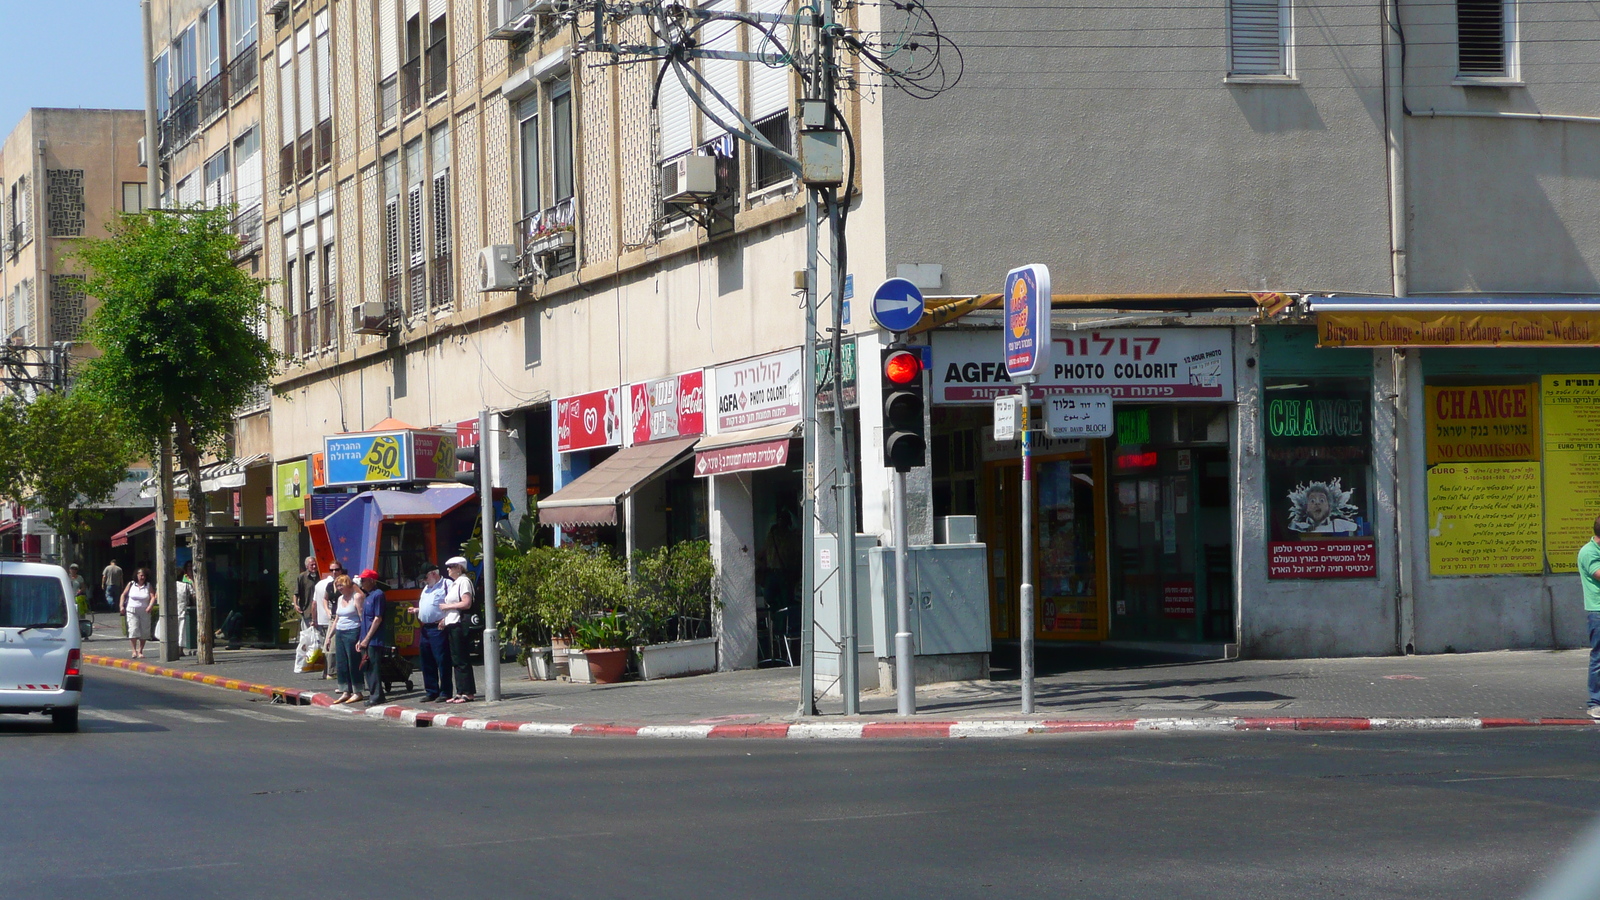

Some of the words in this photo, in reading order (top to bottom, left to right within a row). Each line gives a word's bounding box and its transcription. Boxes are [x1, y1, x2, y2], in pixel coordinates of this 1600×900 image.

[1327, 322, 1358, 341] Bureau
[1363, 322, 1375, 341] De
[1379, 321, 1413, 345] Change
[1421, 321, 1455, 345] Foreign
[1460, 321, 1501, 344] Exchange
[1512, 321, 1544, 341] Cambio
[1553, 321, 1589, 340] Wechsel
[1191, 353, 1205, 362] HOUR
[1206, 349, 1222, 358] PHOTO
[734, 360, 781, 388] קולורית
[944, 362, 1011, 382] AGFA
[1054, 363, 1104, 379] PHOTO
[1114, 363, 1178, 379] COLORIT
[1131, 386, 1174, 396] פיתוח
[719, 393, 738, 413] AGFA
[750, 389, 764, 405] PHOTO
[766, 385, 787, 402] COLORIT
[1053, 398, 1076, 410] בלוך
[1437, 389, 1527, 420] CHANGE
[739, 415, 745, 424] 30
[1269, 399, 1363, 436] CHANGE
[1437, 424, 1467, 437] ישראל
[1471, 425, 1489, 439] בנק
[1493, 424, 1527, 435] באישור
[330, 442, 361, 451] ההגרלה
[1437, 444, 1453, 458] NO
[1457, 443, 1531, 457] COMMISSION
[331, 452, 361, 461] הגדולה
[368, 442, 397, 469] 50
[438, 441, 453, 469] 50
[369, 464, 390, 478] מיליון
[1273, 544, 1292, 554] טלפון
[1300, 555, 1318, 564] בארץ
[1271, 566, 1290, 575] הארץ
[394, 606, 415, 625] 50
